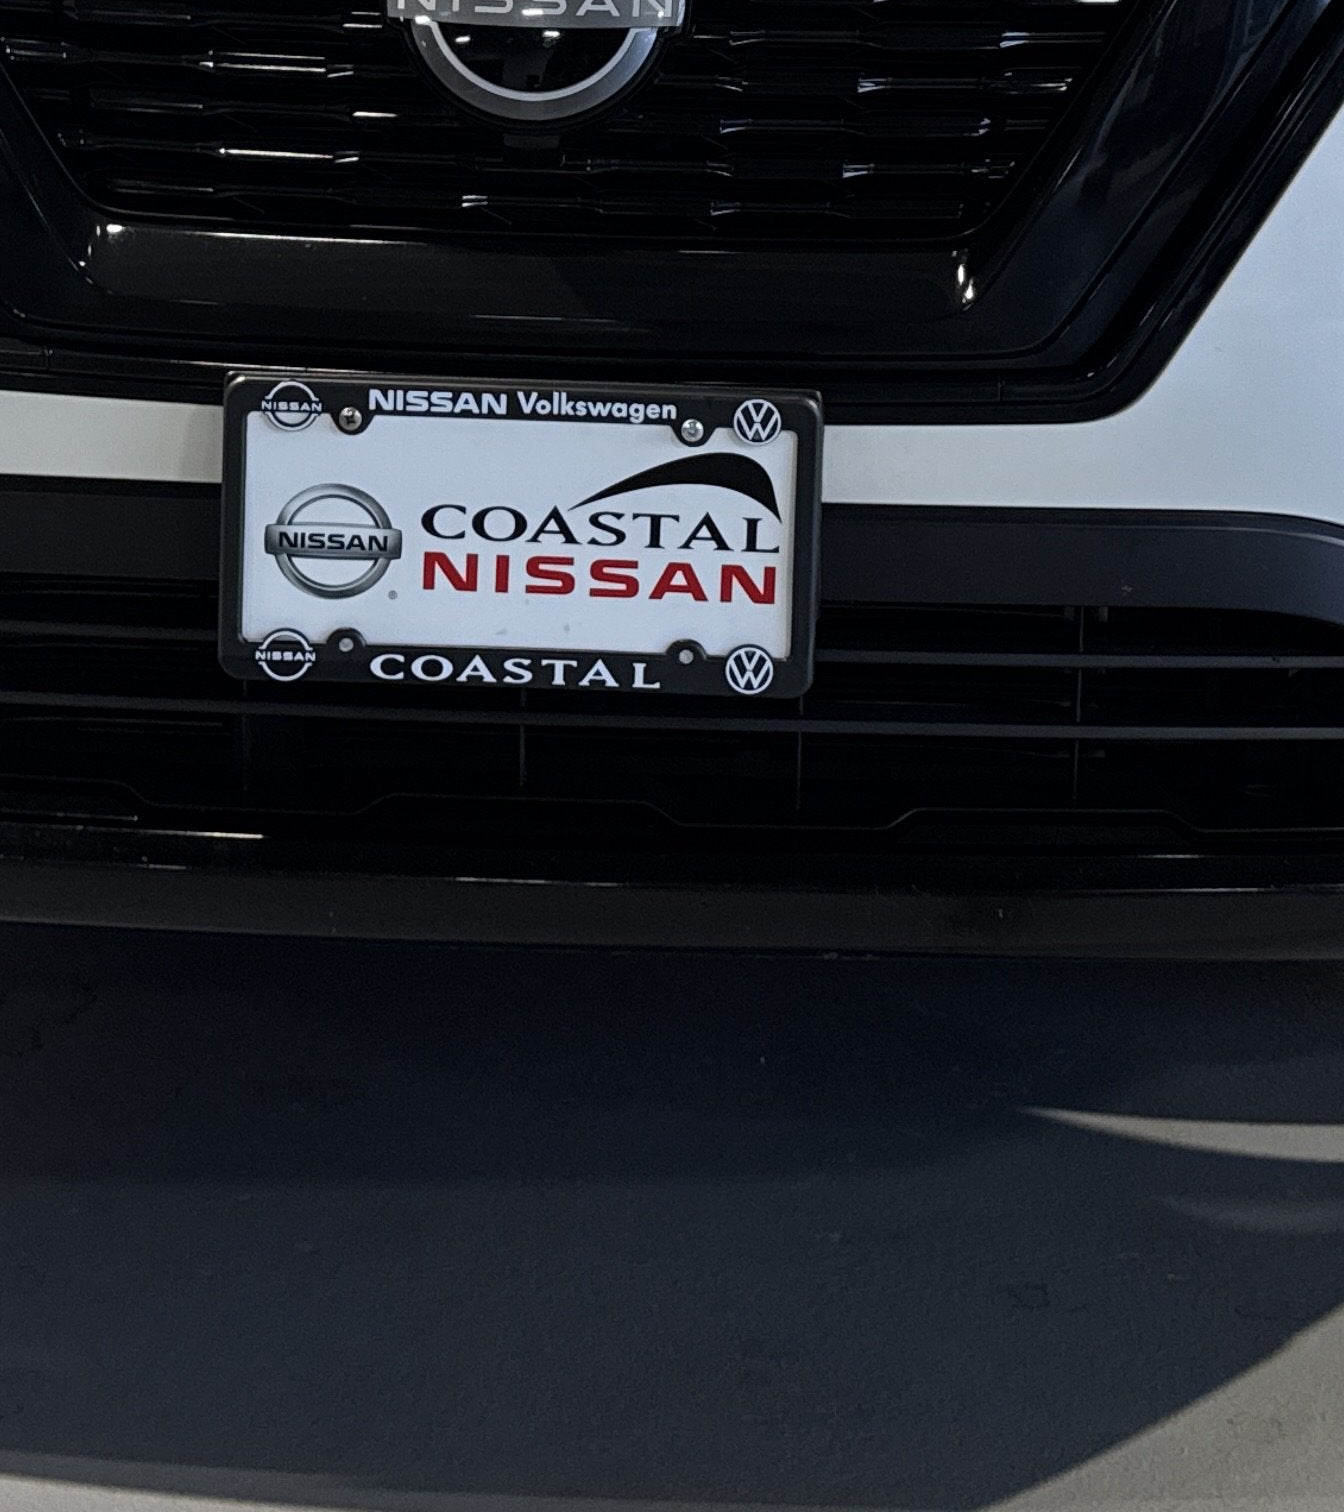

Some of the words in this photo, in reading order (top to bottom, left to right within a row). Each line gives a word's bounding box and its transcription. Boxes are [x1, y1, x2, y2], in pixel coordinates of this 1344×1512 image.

[261, 399, 323, 412] NISSAN
[367, 388, 508, 416] NISSAN
[516, 390, 678, 424] Volkswagen
[278, 530, 389, 553] NISSAN
[420, 502, 781, 554] COASTAL
[422, 551, 777, 605] NISSAN
[255, 650, 316, 662] NISSAN
[369, 653, 661, 689] COASTAL
